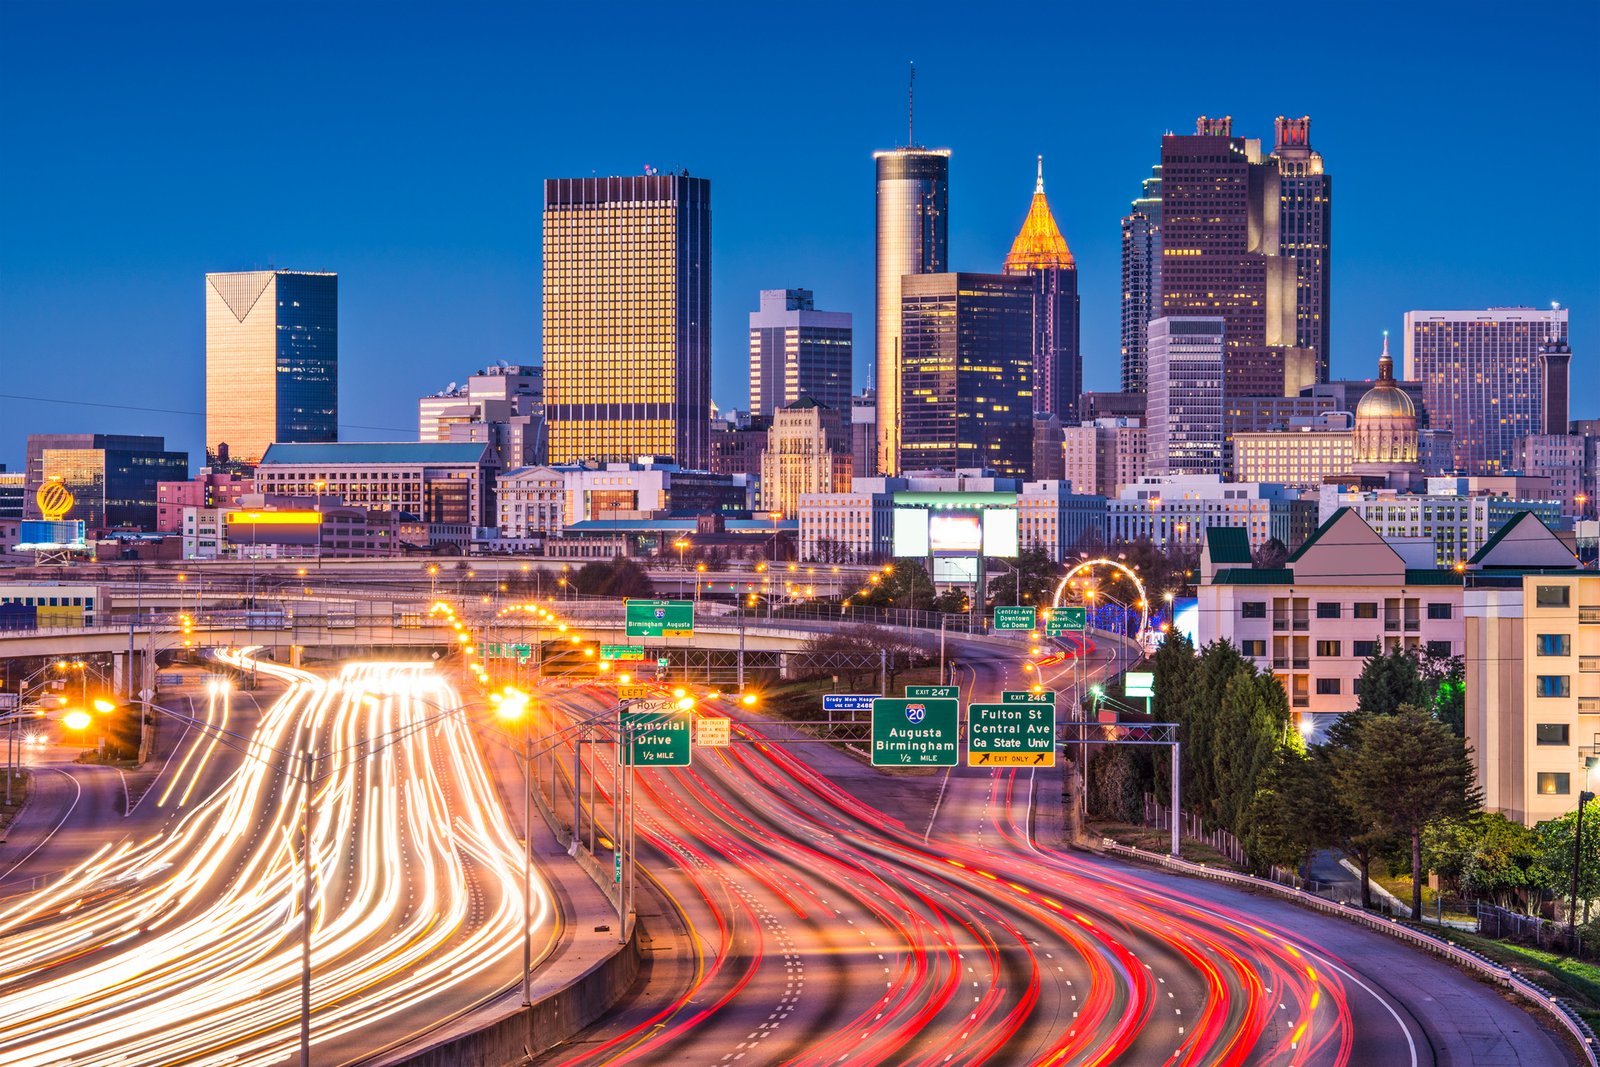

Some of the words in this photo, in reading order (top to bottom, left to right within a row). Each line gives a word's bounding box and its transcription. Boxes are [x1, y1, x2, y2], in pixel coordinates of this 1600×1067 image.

[909, 709, 924, 720] 20
[981, 710, 1021, 719] Fulton
[1028, 710, 1042, 719] St
[626, 720, 684, 730] Memorial
[973, 724, 1020, 733] Central
[1027, 724, 1050, 733] Ave
[890, 728, 942, 740] Augusta
[638, 736, 671, 744] Drive
[973, 738, 987, 747] Ga
[994, 738, 1021, 747] State
[1028, 738, 1049, 747] Univ
[876, 741, 954, 753] Birmingham
